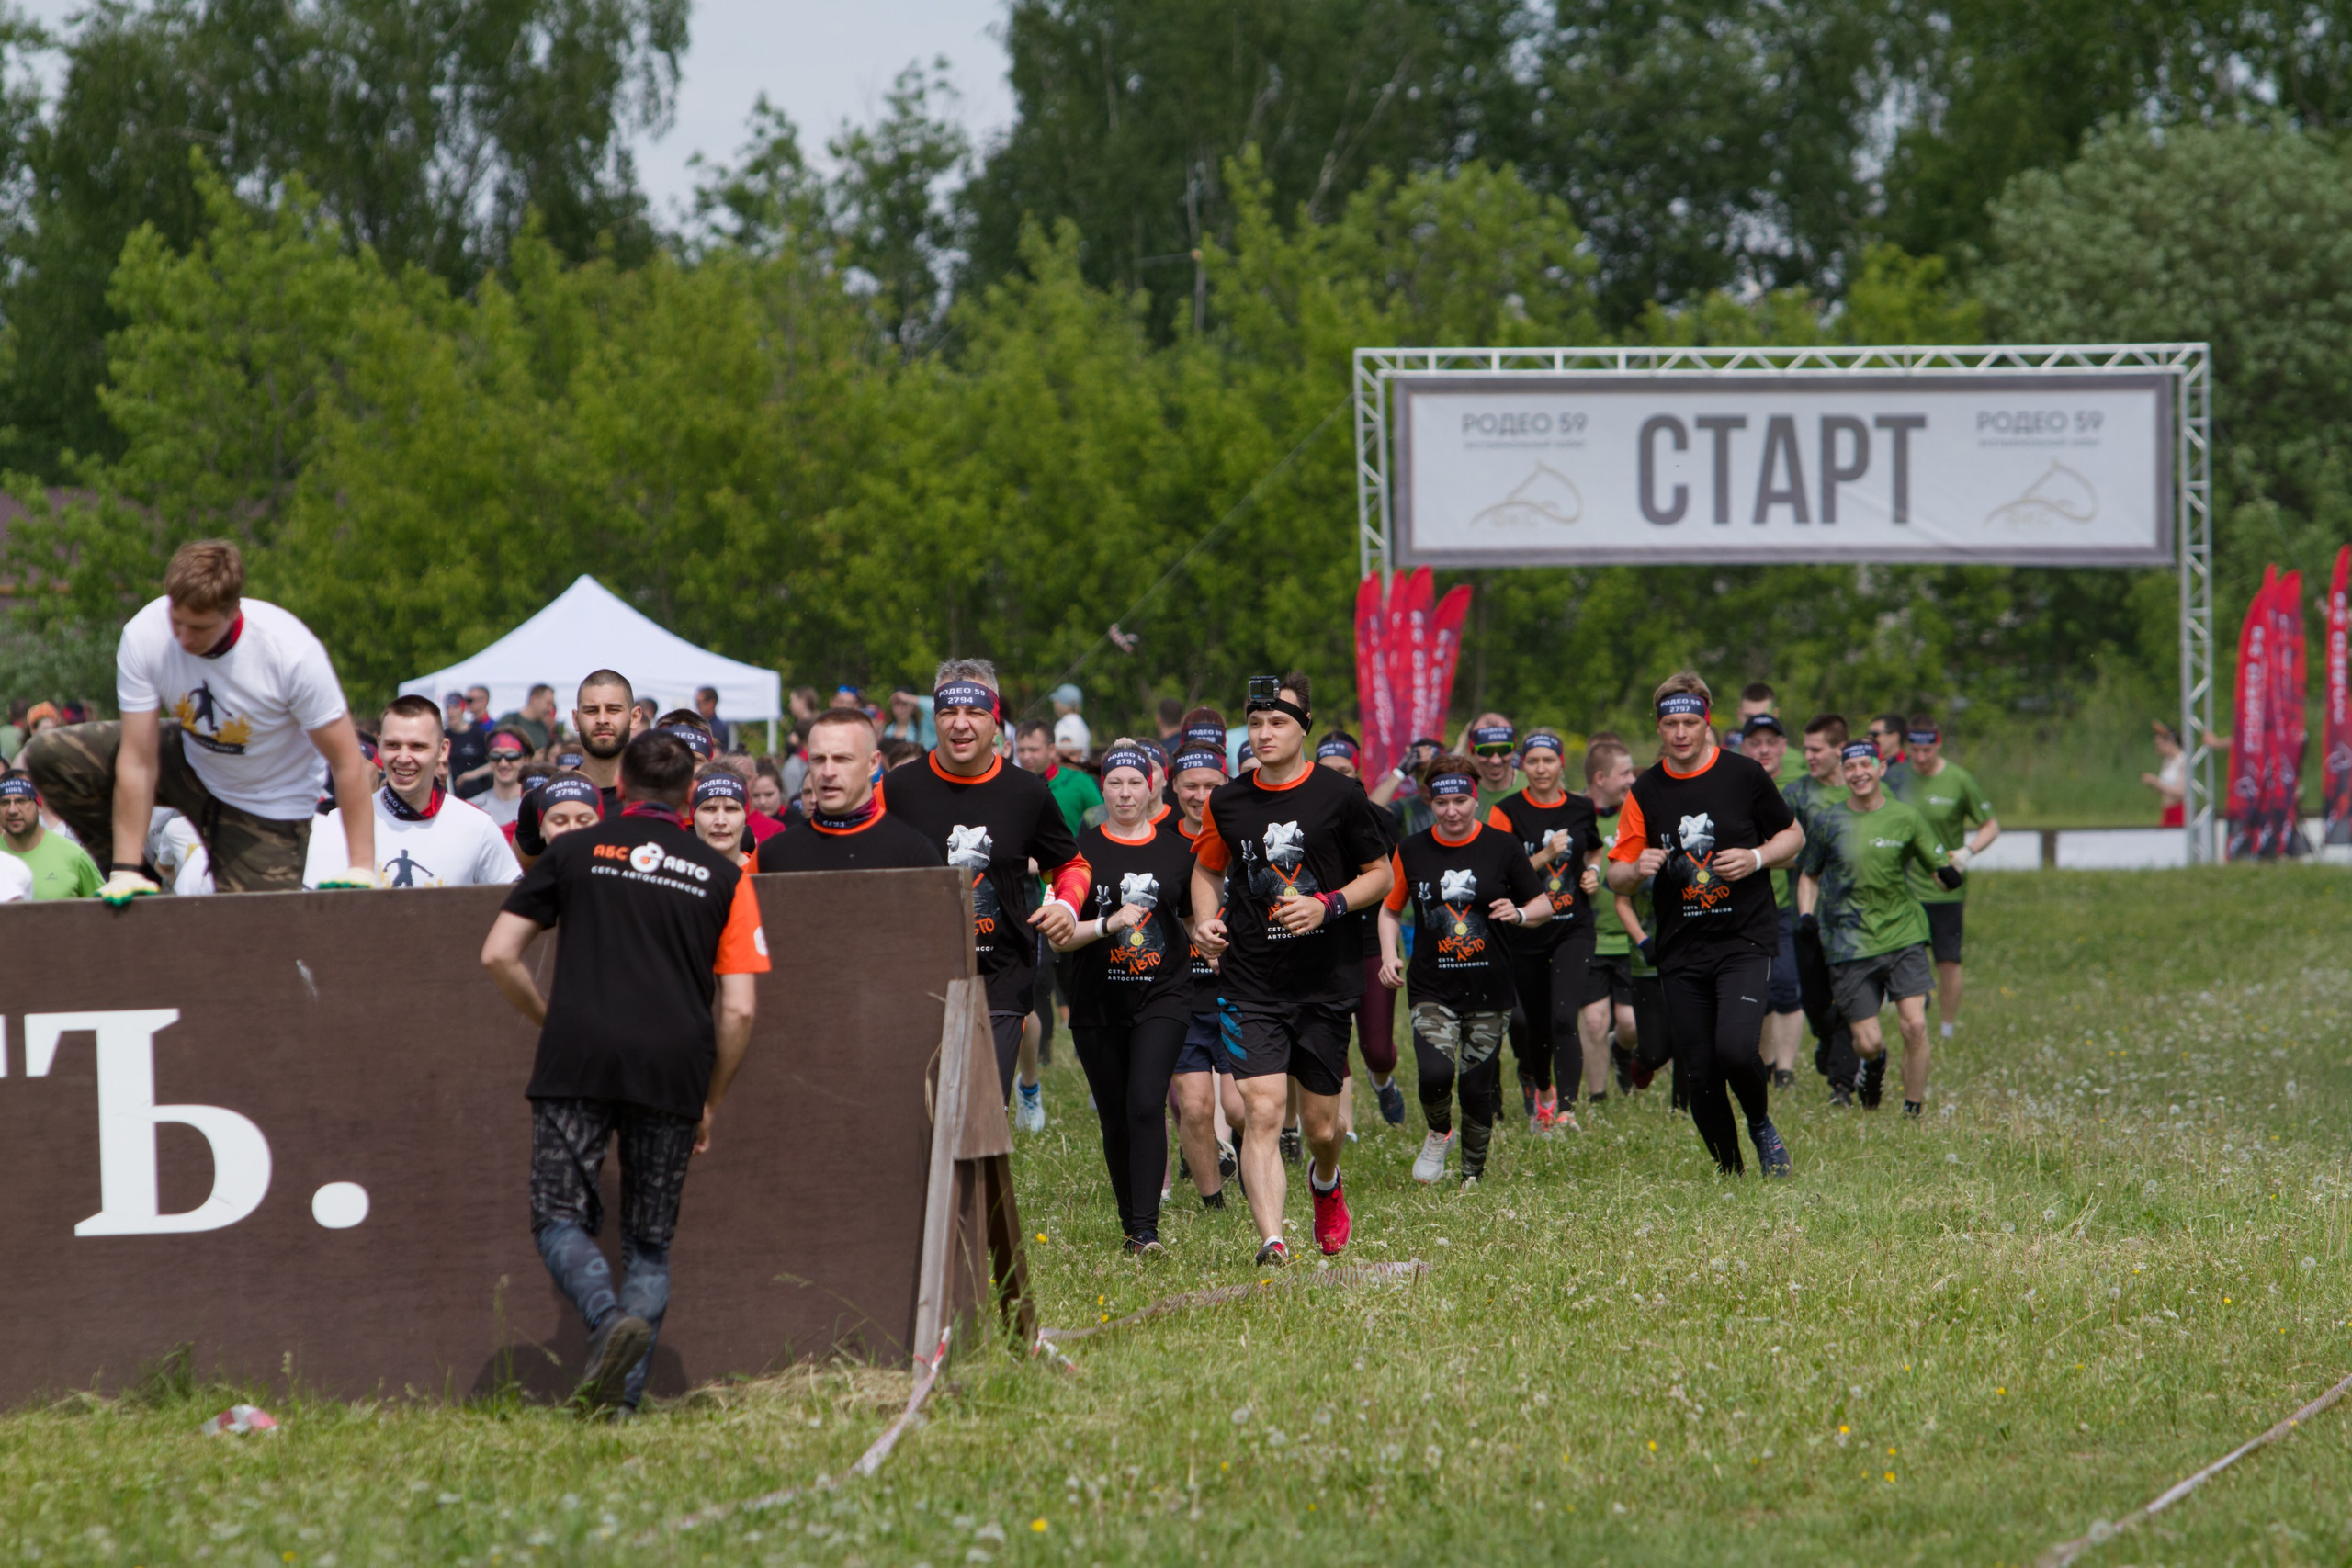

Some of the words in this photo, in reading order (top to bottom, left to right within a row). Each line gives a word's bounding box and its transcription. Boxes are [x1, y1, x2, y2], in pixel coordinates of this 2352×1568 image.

[1462, 412, 1553, 436] РОДЕО
[1559, 412, 1589, 434] 59
[1977, 412, 2069, 435] РОДЕО
[2074, 411, 2105, 434] 59
[1638, 415, 1928, 525] СТАРТ
[938, 687, 971, 698] РОДЕО
[974, 688, 986, 696] 59
[947, 696, 974, 705] 2794
[1660, 698, 1689, 707] РОДЕО
[1690, 698, 1702, 706] 59
[696, 735, 707, 744] 59
[1107, 751, 1136, 762] РОДЕО
[1137, 755, 1147, 764] 59
[1116, 758, 1136, 766] 2791
[1176, 753, 1202, 764] РОДЕО
[1182, 760, 1204, 769] 2795
[0, 780, 21, 788] ОДЕО
[545, 780, 579, 795] РОДЕО
[580, 782, 592, 791] 59
[698, 778, 731, 792] РОДЕО
[732, 782, 742, 791] 59
[1431, 778, 1458, 788] РОДЕО
[555, 788, 582, 797] 2796
[707, 787, 733, 796] 2799
[1440, 786, 1459, 795] 2805
[593, 843, 629, 862] АБС
[663, 855, 711, 882] АВТО
[591, 865, 620, 876] СЕТЬ
[621, 869, 707, 898] АВТОСЕРВИСОВ
[1456, 937, 1485, 962] АВТО
[1128, 951, 1161, 975] АВТО
[0, 1008, 369, 1236] Ъ.
